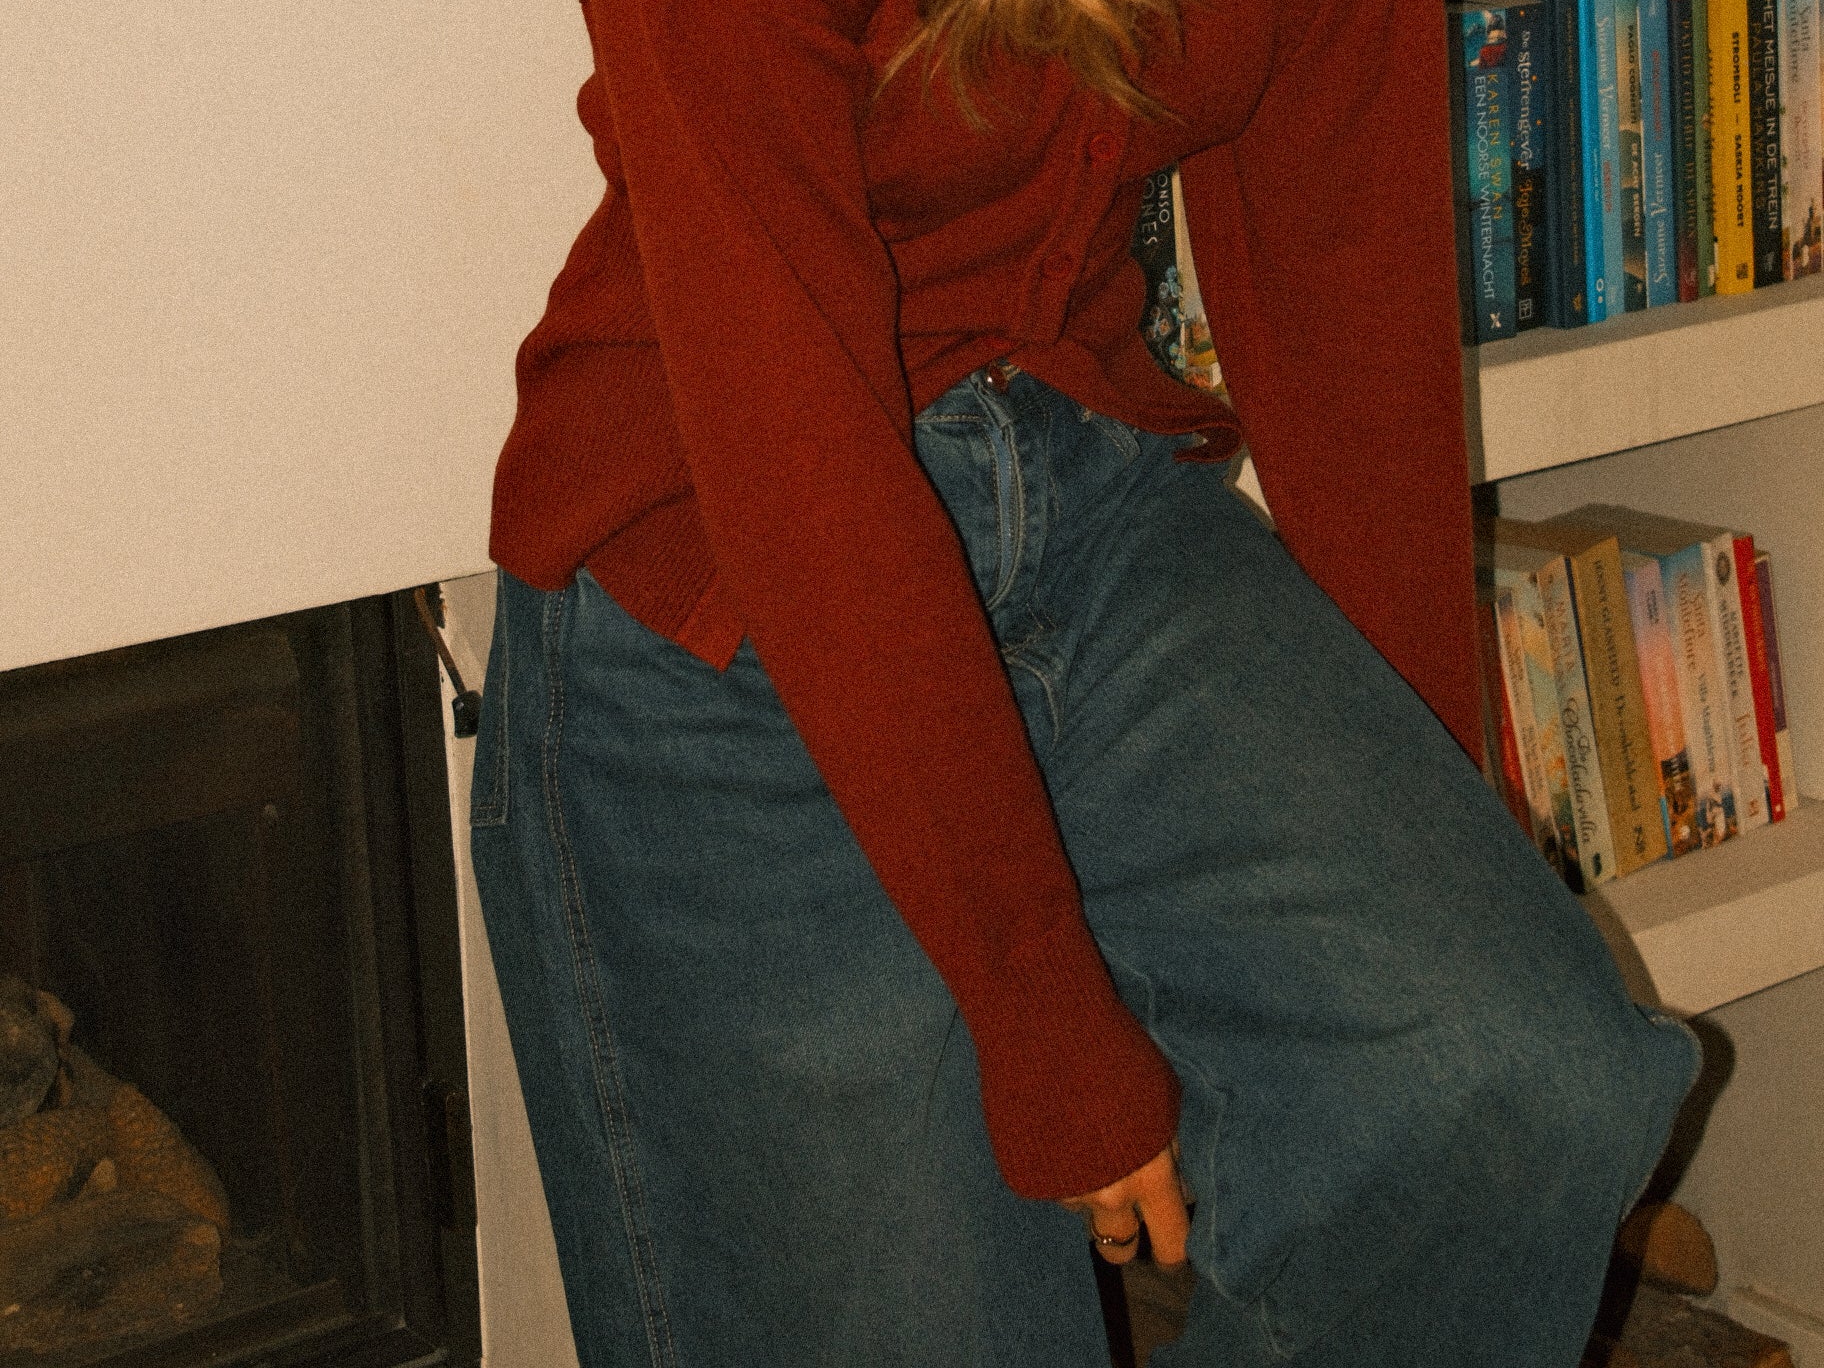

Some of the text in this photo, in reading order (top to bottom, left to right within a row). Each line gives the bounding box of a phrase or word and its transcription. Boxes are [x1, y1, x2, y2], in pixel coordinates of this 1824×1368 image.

[1596, 16, 1611, 81] Suzanne
[1627, 25, 1636, 64] PAOLO
[1764, 39, 1778, 111] MEISJE
[1487, 73, 1503, 220] KAREN SWAN
[1598, 83, 1614, 150] Vermeer
[1731, 31, 1745, 228] STROMBOLI SASKIA NOORT
[1766, 117, 1777, 136] IN
[1474, 75, 1496, 300] EEN NOORSE WINTERNACHT
[1650, 152, 1667, 217] Vermeer
[1766, 143, 1778, 170] DE
[1630, 143, 1642, 238] DE ACHT BERGEN
[1767, 173, 1779, 230] TREIN
[1516, 179, 1534, 287] Jojo Moyes
[1653, 220, 1670, 285] Suzanne
[1692, 592, 1707, 638] Santa
[1562, 697, 1597, 845] Chocoladevilla
